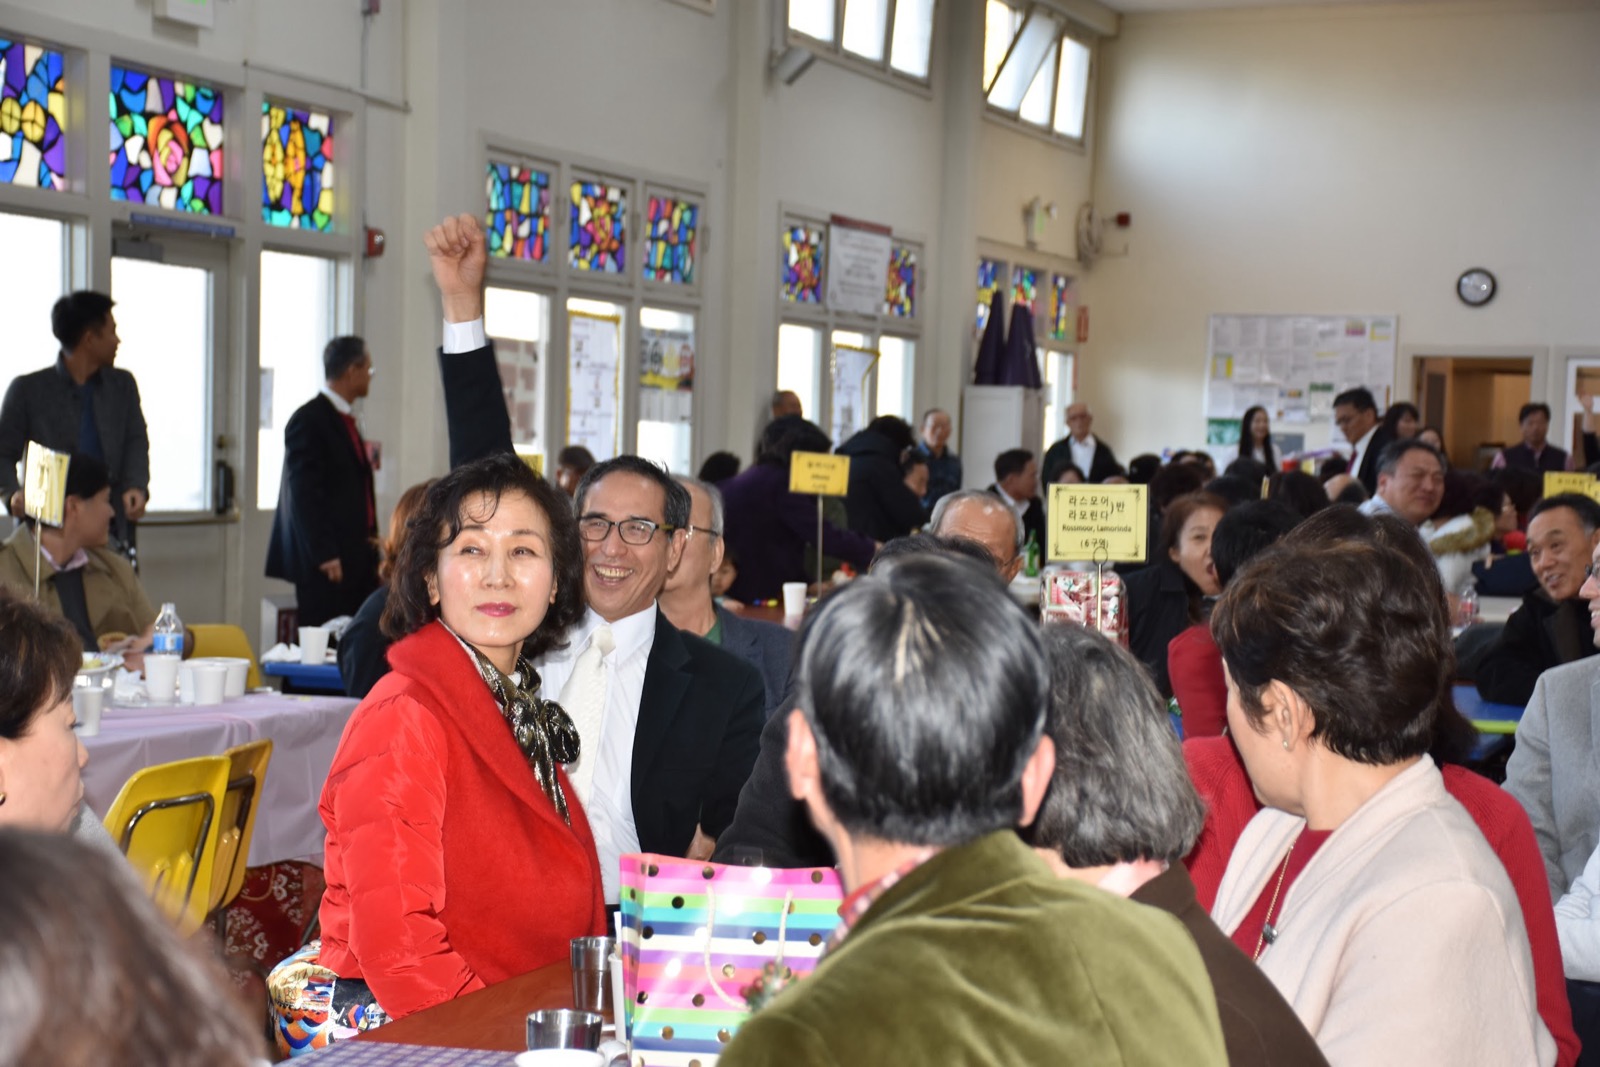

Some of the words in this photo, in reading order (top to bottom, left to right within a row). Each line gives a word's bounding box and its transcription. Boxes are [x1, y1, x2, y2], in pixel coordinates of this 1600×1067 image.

[1069, 495, 1109, 507] 라스모어
[1062, 524, 1095, 533] Rossmoor,
[1096, 524, 1132, 532] Lamorinda
